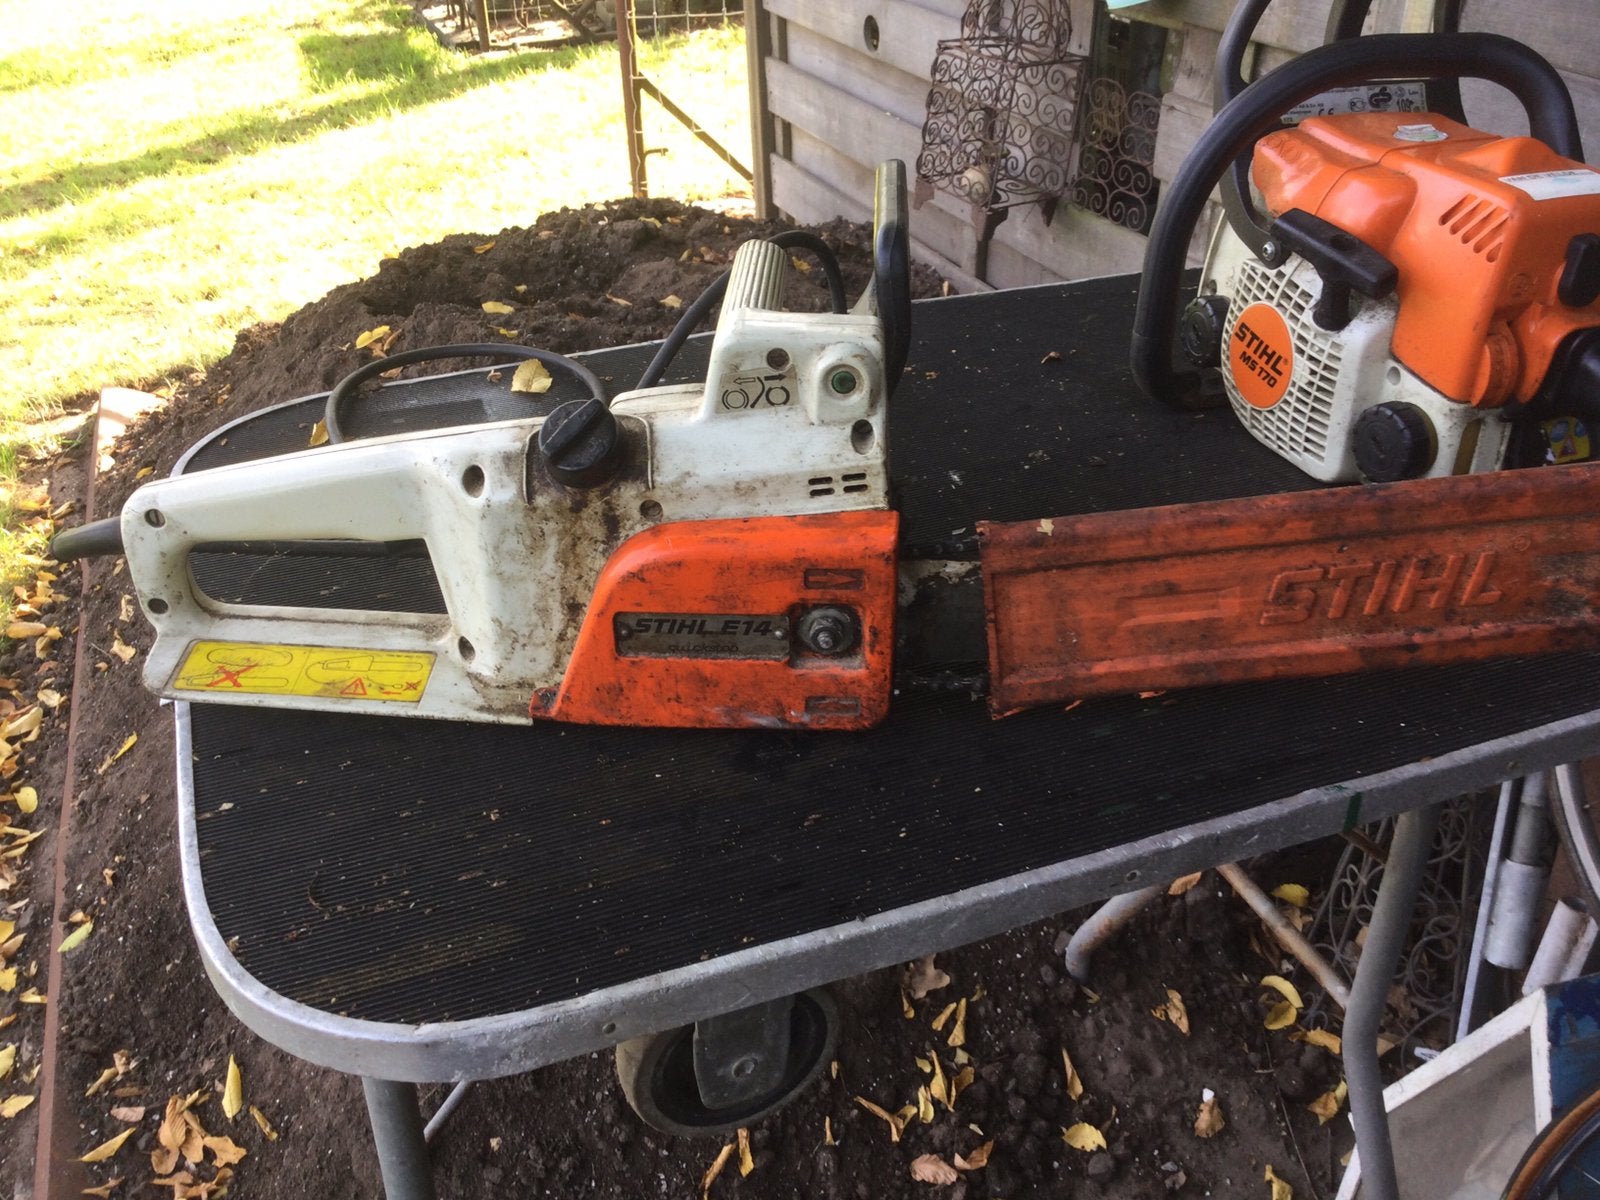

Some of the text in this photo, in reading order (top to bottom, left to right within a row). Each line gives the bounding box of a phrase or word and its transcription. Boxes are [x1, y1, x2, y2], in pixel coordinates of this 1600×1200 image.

[1234, 322, 1284, 377] STIHL
[1239, 351, 1278, 388] MS 170
[1259, 550, 1504, 626] STIHL
[633, 618, 773, 636] STIHL E14
